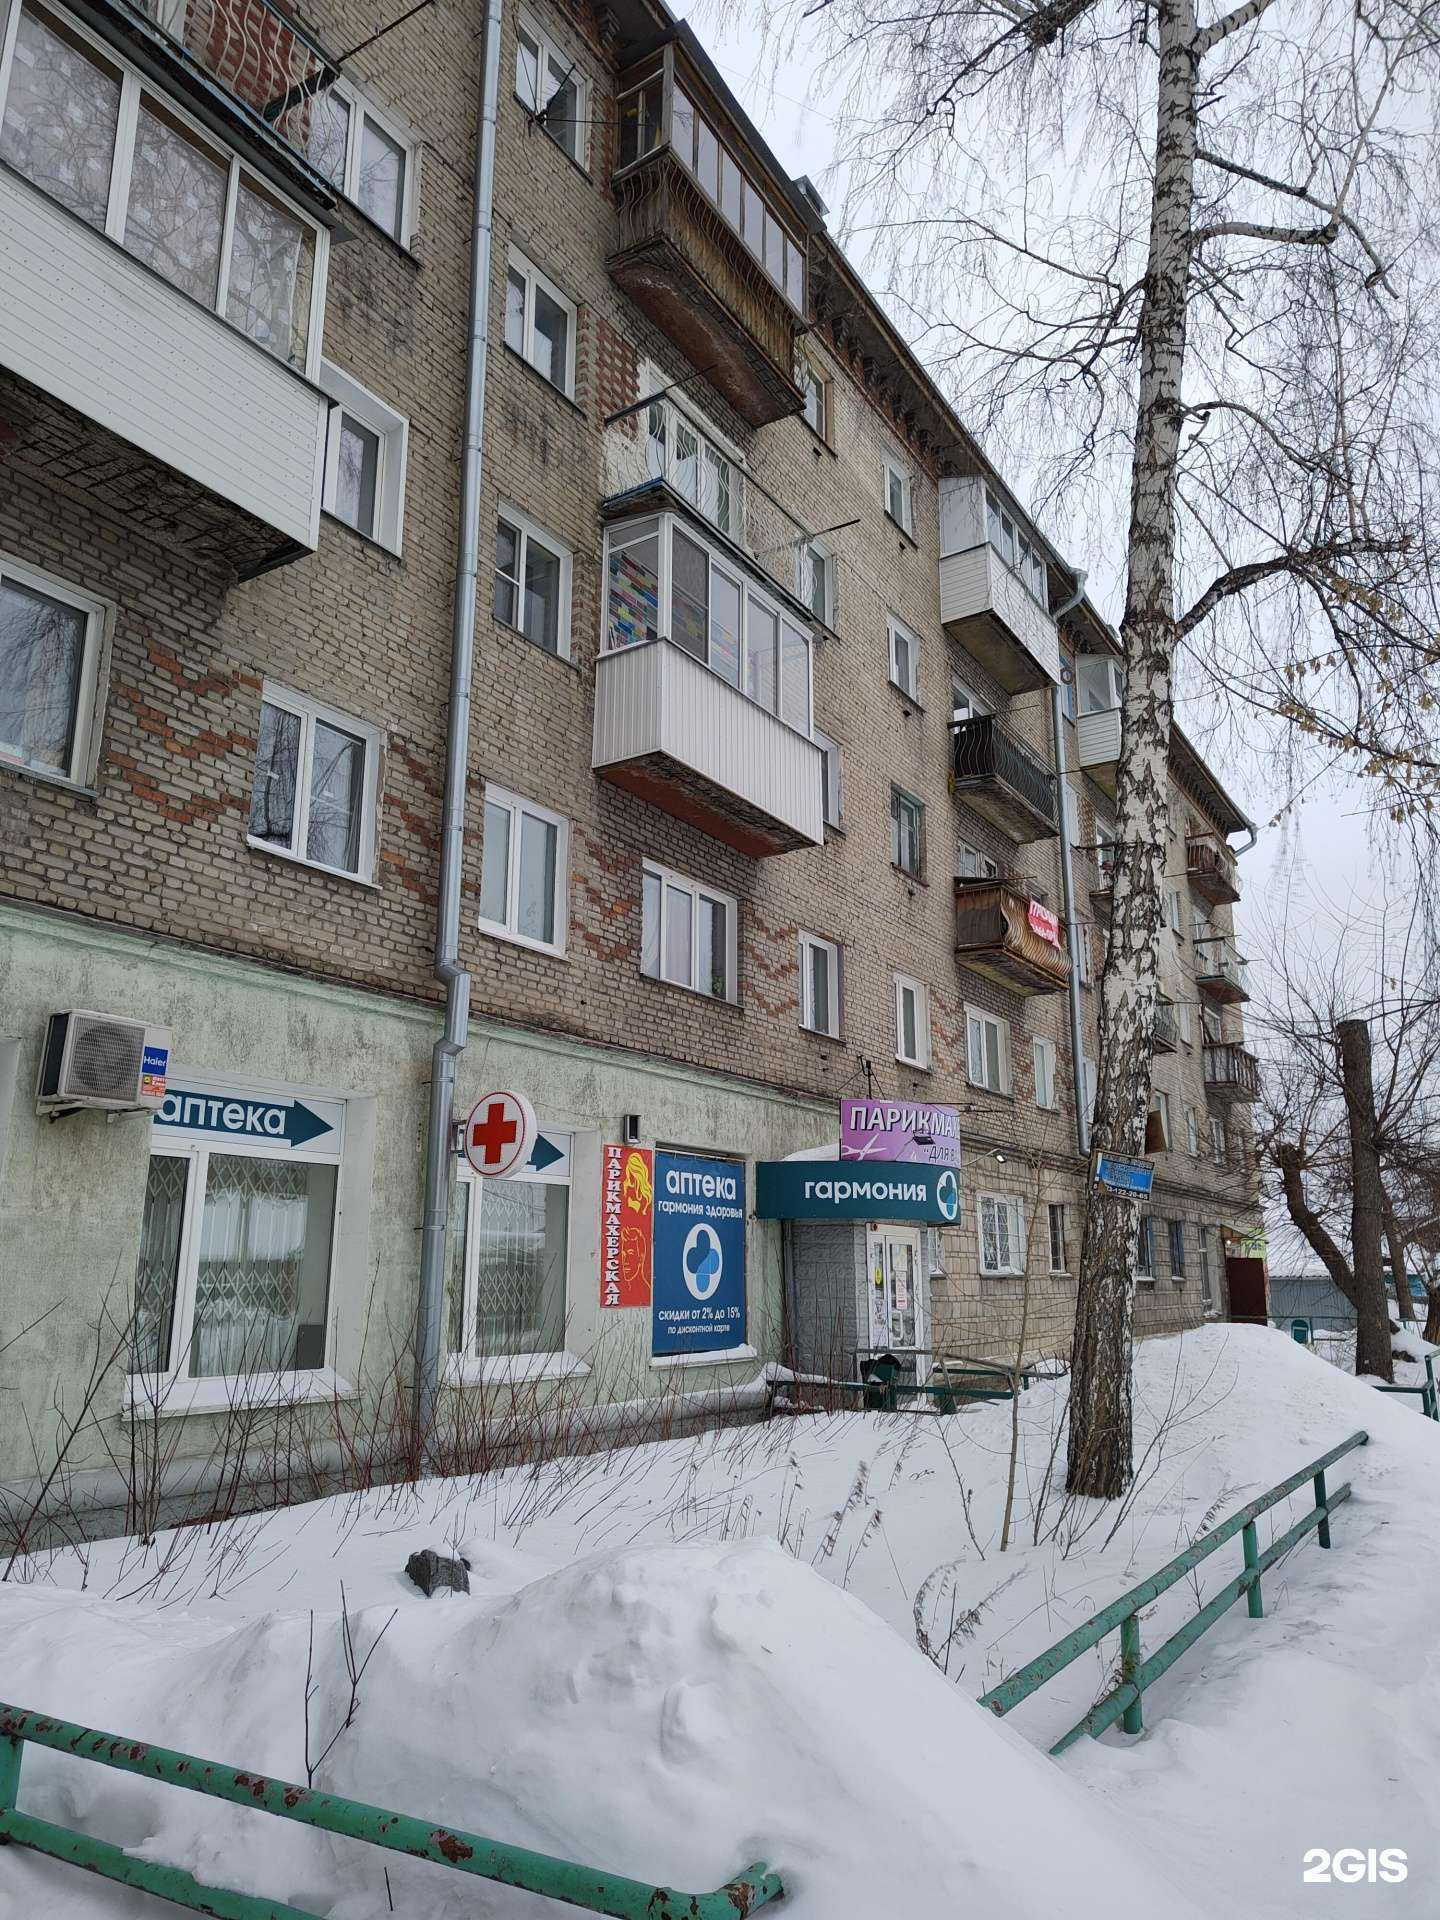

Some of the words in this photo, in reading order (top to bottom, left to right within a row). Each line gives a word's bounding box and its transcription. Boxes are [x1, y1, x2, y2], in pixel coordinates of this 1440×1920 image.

[144, 1056, 166, 1067] Haier
[157, 1093, 286, 1135] аптека
[666, 1170, 736, 1200] аптека
[804, 1181, 927, 1204] гармония
[658, 1201, 704, 1215] гармония
[706, 1205, 743, 1219] здоровья
[604, 1147, 622, 1305] ПАРИКМАХЕРСКАЯ
[658, 1310, 690, 1322] скидки
[691, 1310, 701, 1320] от
[702, 1307, 713, 1319] 2%
[714, 1309, 725, 1321] до
[727, 1306, 740, 1319] 15%
